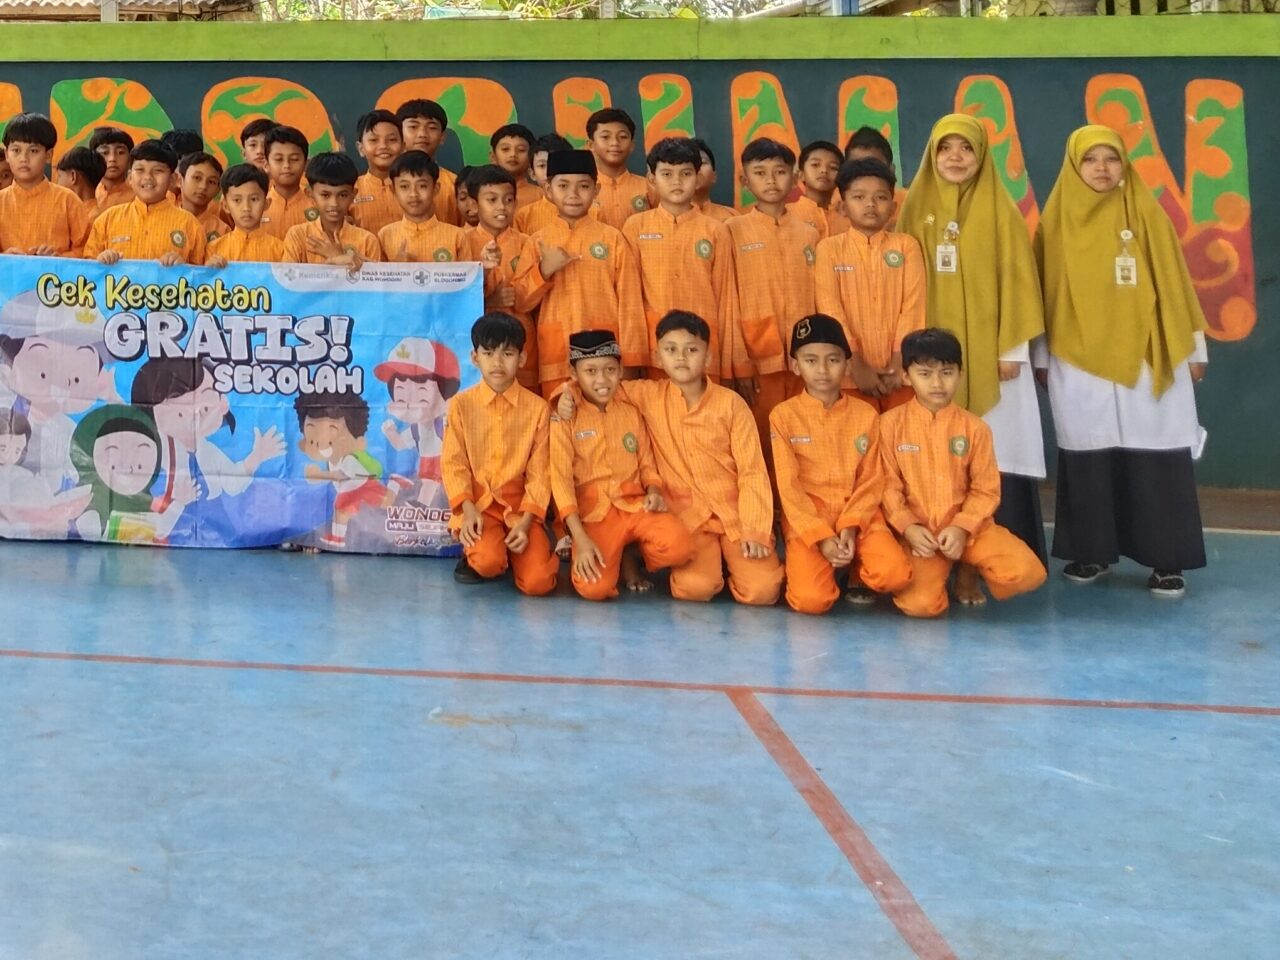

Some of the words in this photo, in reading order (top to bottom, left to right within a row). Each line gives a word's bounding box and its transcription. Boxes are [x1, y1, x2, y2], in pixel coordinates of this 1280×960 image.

[37, 273, 97, 309] Cek
[105, 274, 271, 312] Kesehatan
[103, 311, 356, 365] GRATIS!
[213, 363, 365, 396] SEKOLAH
